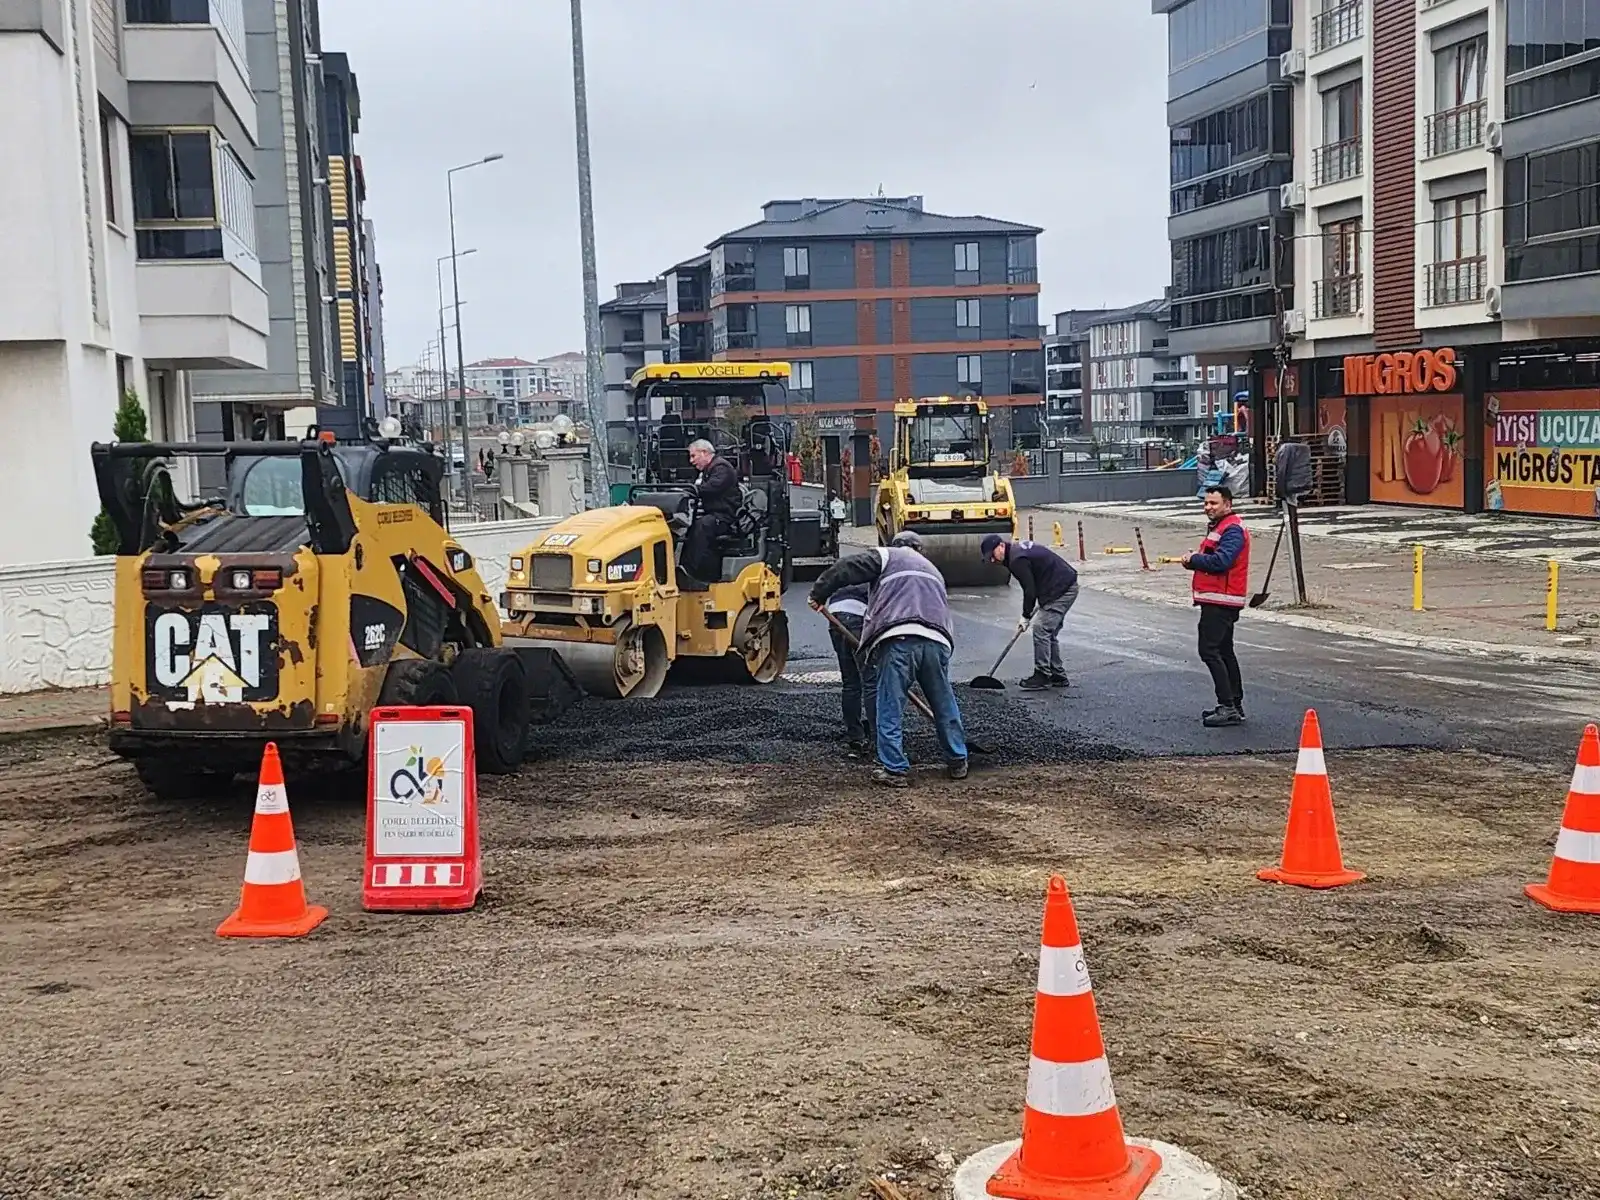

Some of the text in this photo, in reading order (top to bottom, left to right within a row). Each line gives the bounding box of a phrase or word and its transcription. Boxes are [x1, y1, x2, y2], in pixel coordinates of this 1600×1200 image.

[544, 534, 578, 546] CAT
[453, 553, 465, 571] CAT
[607, 565, 623, 580] CAT
[365, 623, 386, 645] 262C
[154, 612, 269, 688] CAT
